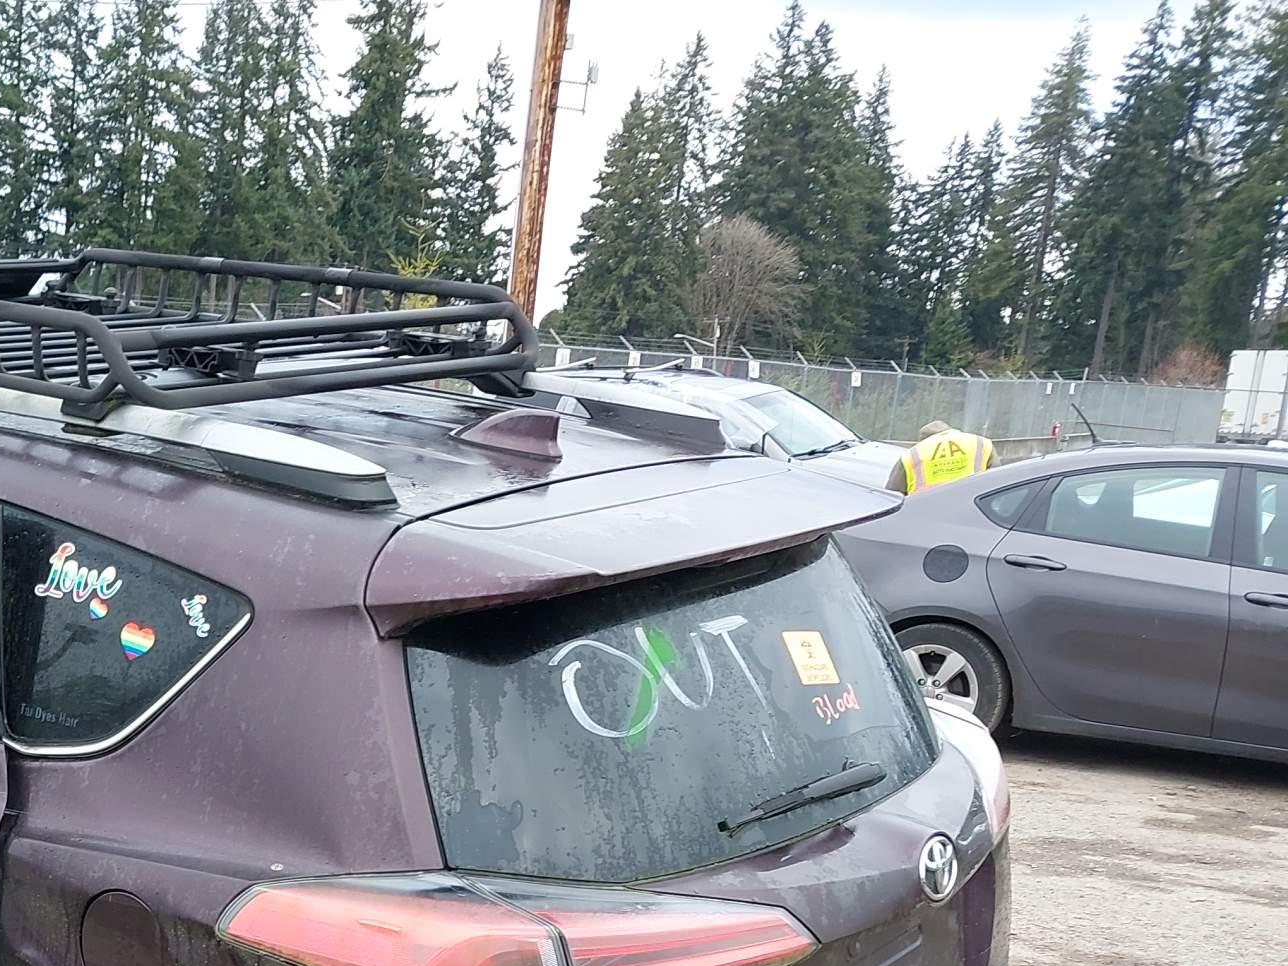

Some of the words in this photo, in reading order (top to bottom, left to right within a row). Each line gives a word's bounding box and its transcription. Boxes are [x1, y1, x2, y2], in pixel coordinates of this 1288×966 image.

[548, 615, 776, 759] OUT
[811, 682, 860, 725] Blood
[35, 706, 57, 723] Dyes
